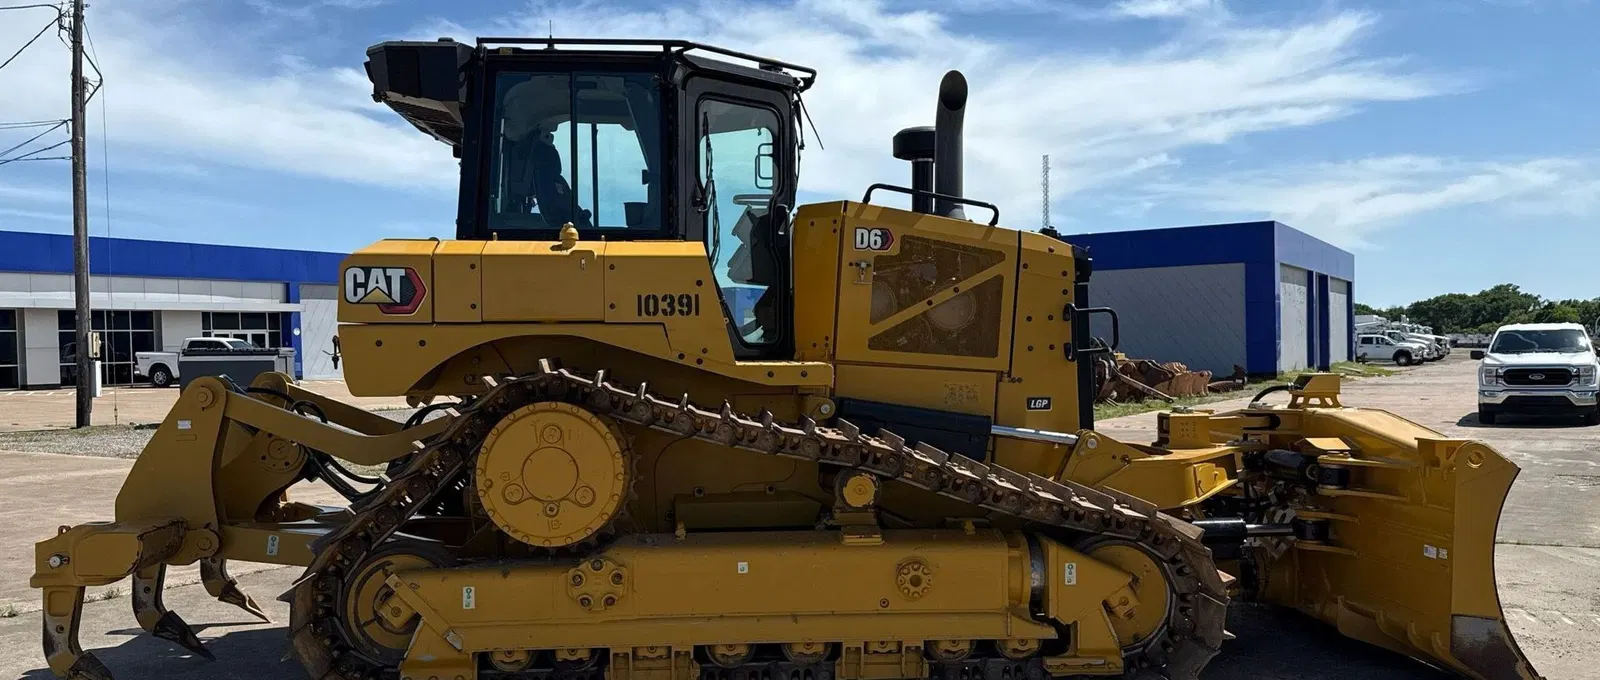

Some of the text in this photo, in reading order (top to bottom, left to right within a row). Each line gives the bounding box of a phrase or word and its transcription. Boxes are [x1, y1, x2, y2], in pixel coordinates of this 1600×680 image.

[855, 228, 882, 250] D6
[345, 267, 405, 304] CAT
[637, 293, 700, 317] 10391
[1030, 399, 1049, 409] LGP
